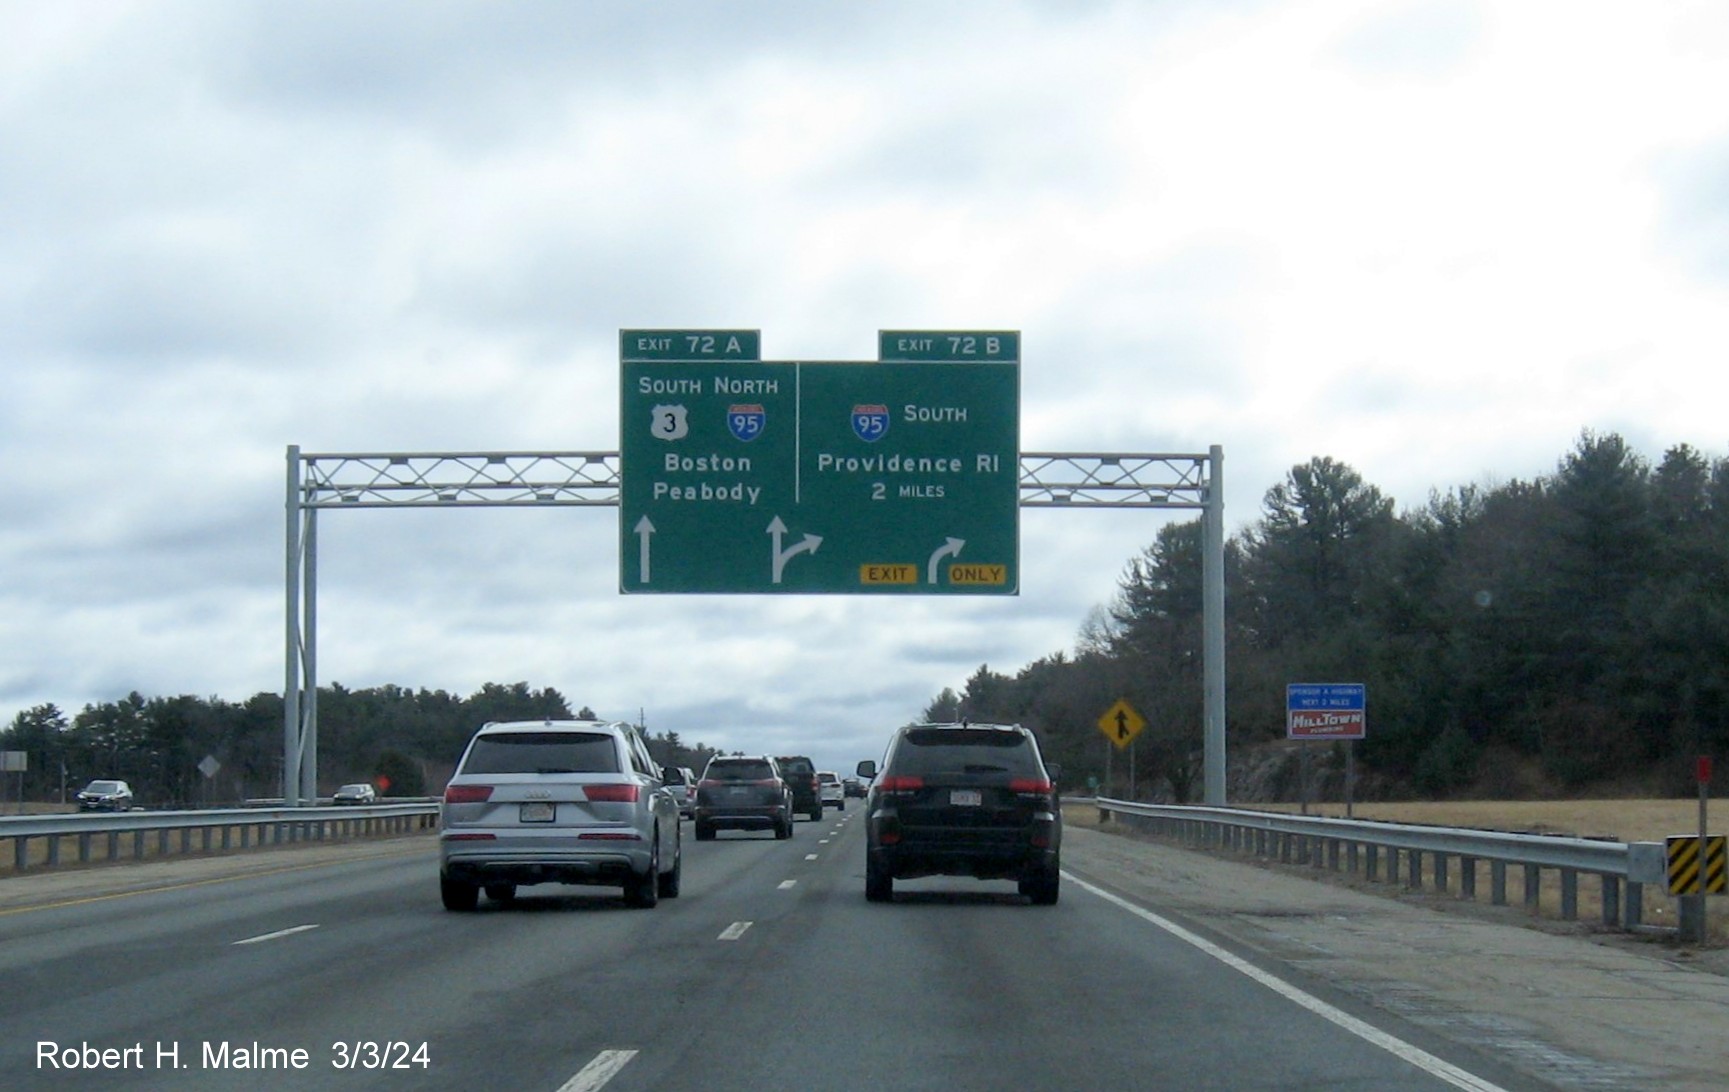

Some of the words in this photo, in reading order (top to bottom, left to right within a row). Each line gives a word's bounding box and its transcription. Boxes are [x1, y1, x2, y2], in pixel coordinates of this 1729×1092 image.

[638, 338, 672, 351] EXIT
[686, 336, 713, 353] 72
[726, 337, 742, 353] A
[897, 339, 932, 352] EXIT
[947, 337, 976, 354] 72
[986, 338, 1000, 354] B
[639, 377, 701, 394] SOUTH
[714, 377, 778, 394] NORTH
[903, 404, 967, 421] SOUTH
[663, 413, 677, 432] 3
[734, 415, 759, 433] 95
[858, 416, 883, 434] 95
[664, 454, 751, 472] Boston
[818, 454, 962, 473] Providence
[976, 455, 999, 472] RI
[653, 483, 761, 504] Peabody
[872, 483, 886, 499] 2
[899, 485, 945, 498] MILES
[869, 567, 908, 581] EXIT
[952, 567, 1000, 581] ONLY
